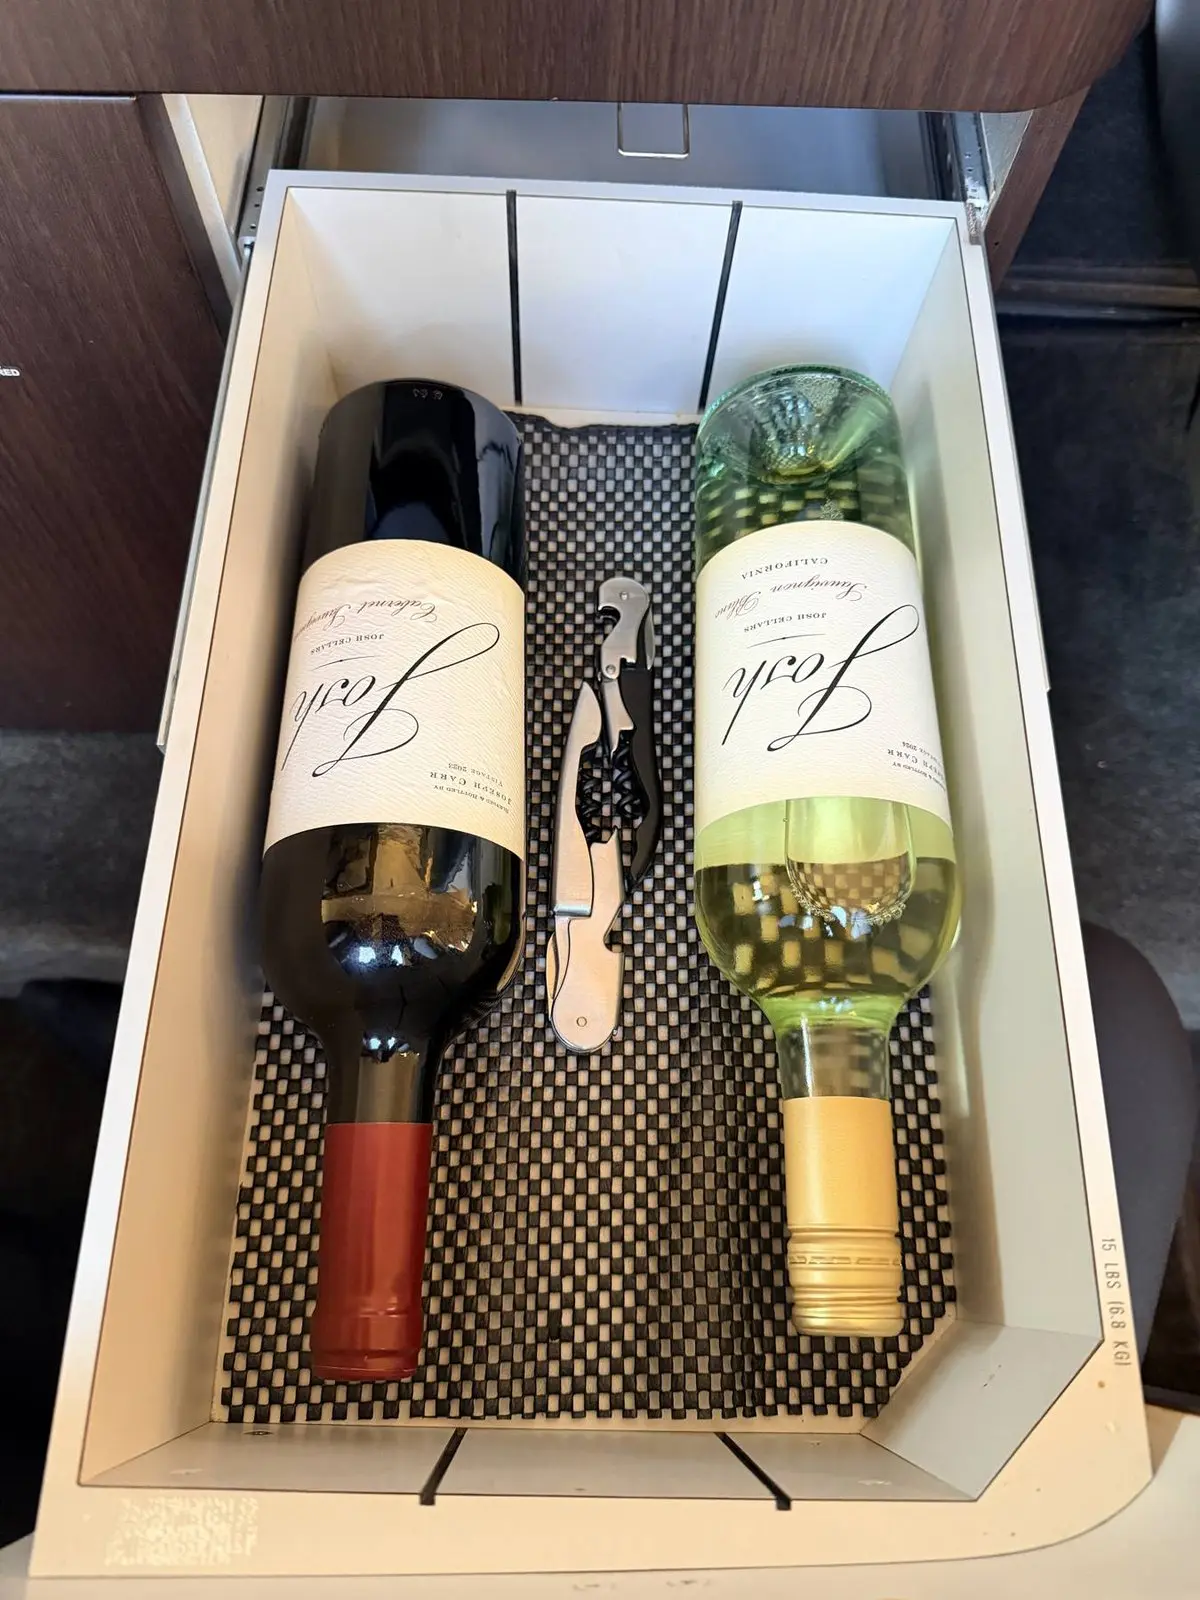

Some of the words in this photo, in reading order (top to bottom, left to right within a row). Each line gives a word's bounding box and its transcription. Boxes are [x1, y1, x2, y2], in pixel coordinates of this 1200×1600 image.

[740, 557, 829, 580] CALIFORNIA
[770, 574, 867, 601] Sauvignon
[357, 599, 438, 626] Cabernet
[713, 590, 761, 620] Blanc
[743, 614, 793, 633] CELLARS
[797, 612, 827, 622] JOSH
[310, 636, 351, 655] CELLARS
[355, 633, 384, 641] JOSH
[721, 604, 920, 752] Josh
[280, 622, 501, 778] Josh
[887, 749, 918, 764] CARR
[429, 771, 466, 786] CARR
[470, 768, 503, 787] VINTAGE
[474, 781, 512, 805] JOSEPH
[1101, 1238, 1117, 1252] 15
[1104, 1262, 1121, 1289] LBS
